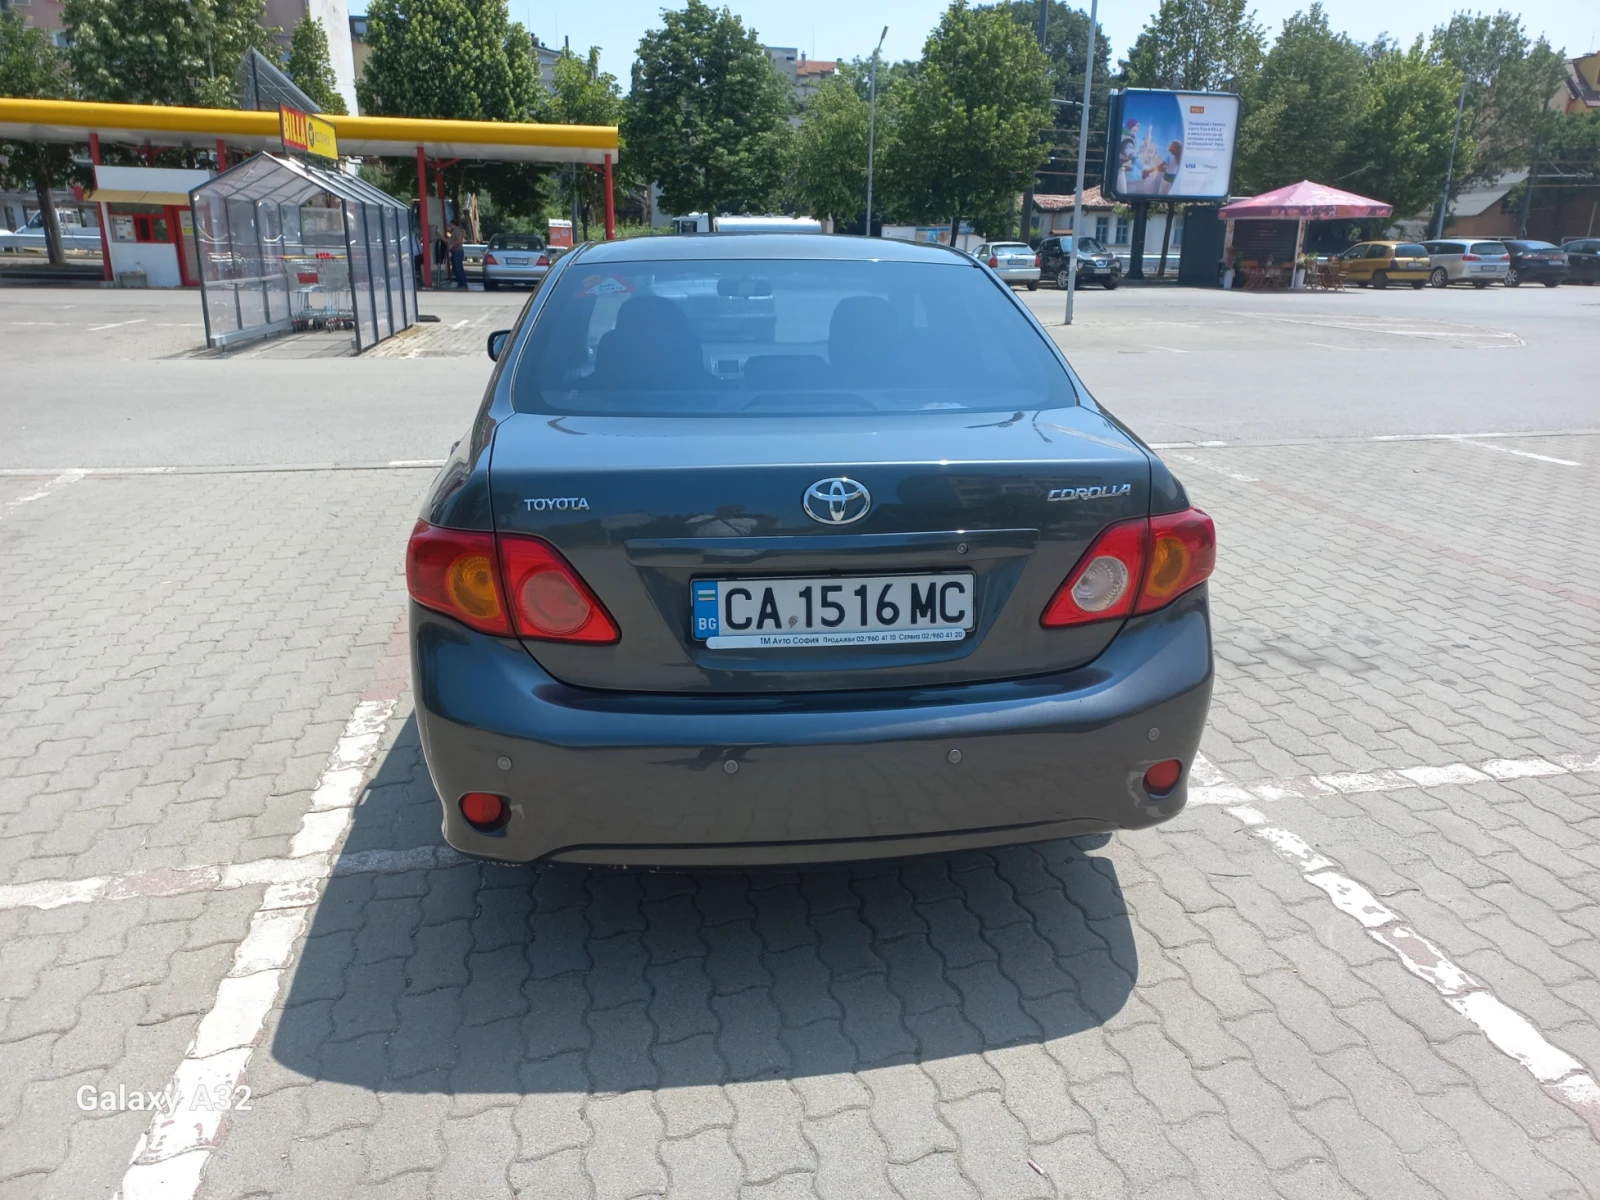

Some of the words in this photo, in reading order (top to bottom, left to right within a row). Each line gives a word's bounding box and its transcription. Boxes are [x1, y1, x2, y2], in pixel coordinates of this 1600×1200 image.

[283, 109, 307, 146] BILLA
[1047, 483, 1131, 501] COROLLA
[524, 497, 590, 511] TOYOTA
[725, 587, 783, 630] CA
[798, 583, 900, 628] 1516
[910, 581, 966, 625] MC
[698, 617, 717, 630] BG
[856, 635, 880, 643] 02/960
[921, 632, 944, 640] 02/960
